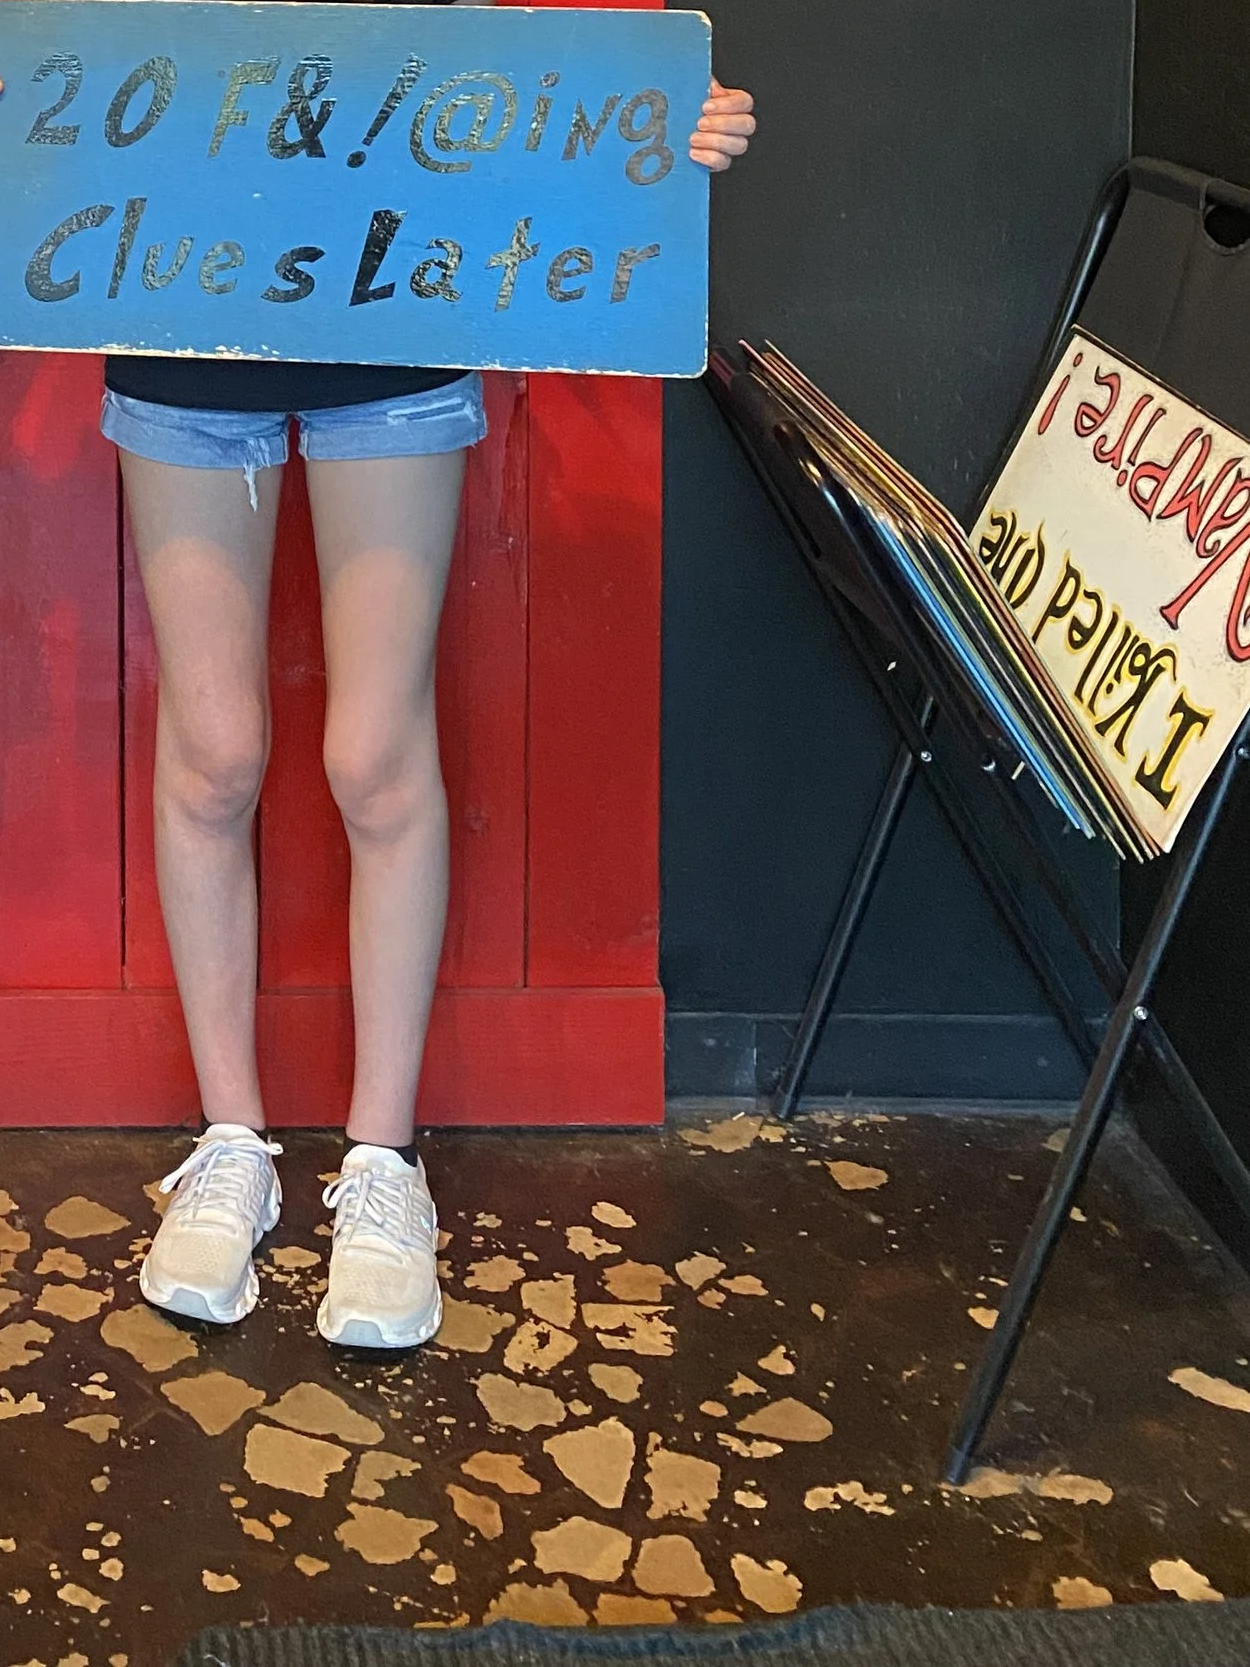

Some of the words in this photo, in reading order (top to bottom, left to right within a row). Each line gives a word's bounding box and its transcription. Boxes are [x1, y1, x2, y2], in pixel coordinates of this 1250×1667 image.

[25, 50, 179, 148] 20
[24, 196, 327, 303] Clues
[347, 208, 661, 313] Later
[1134, 690, 1211, 811] I
